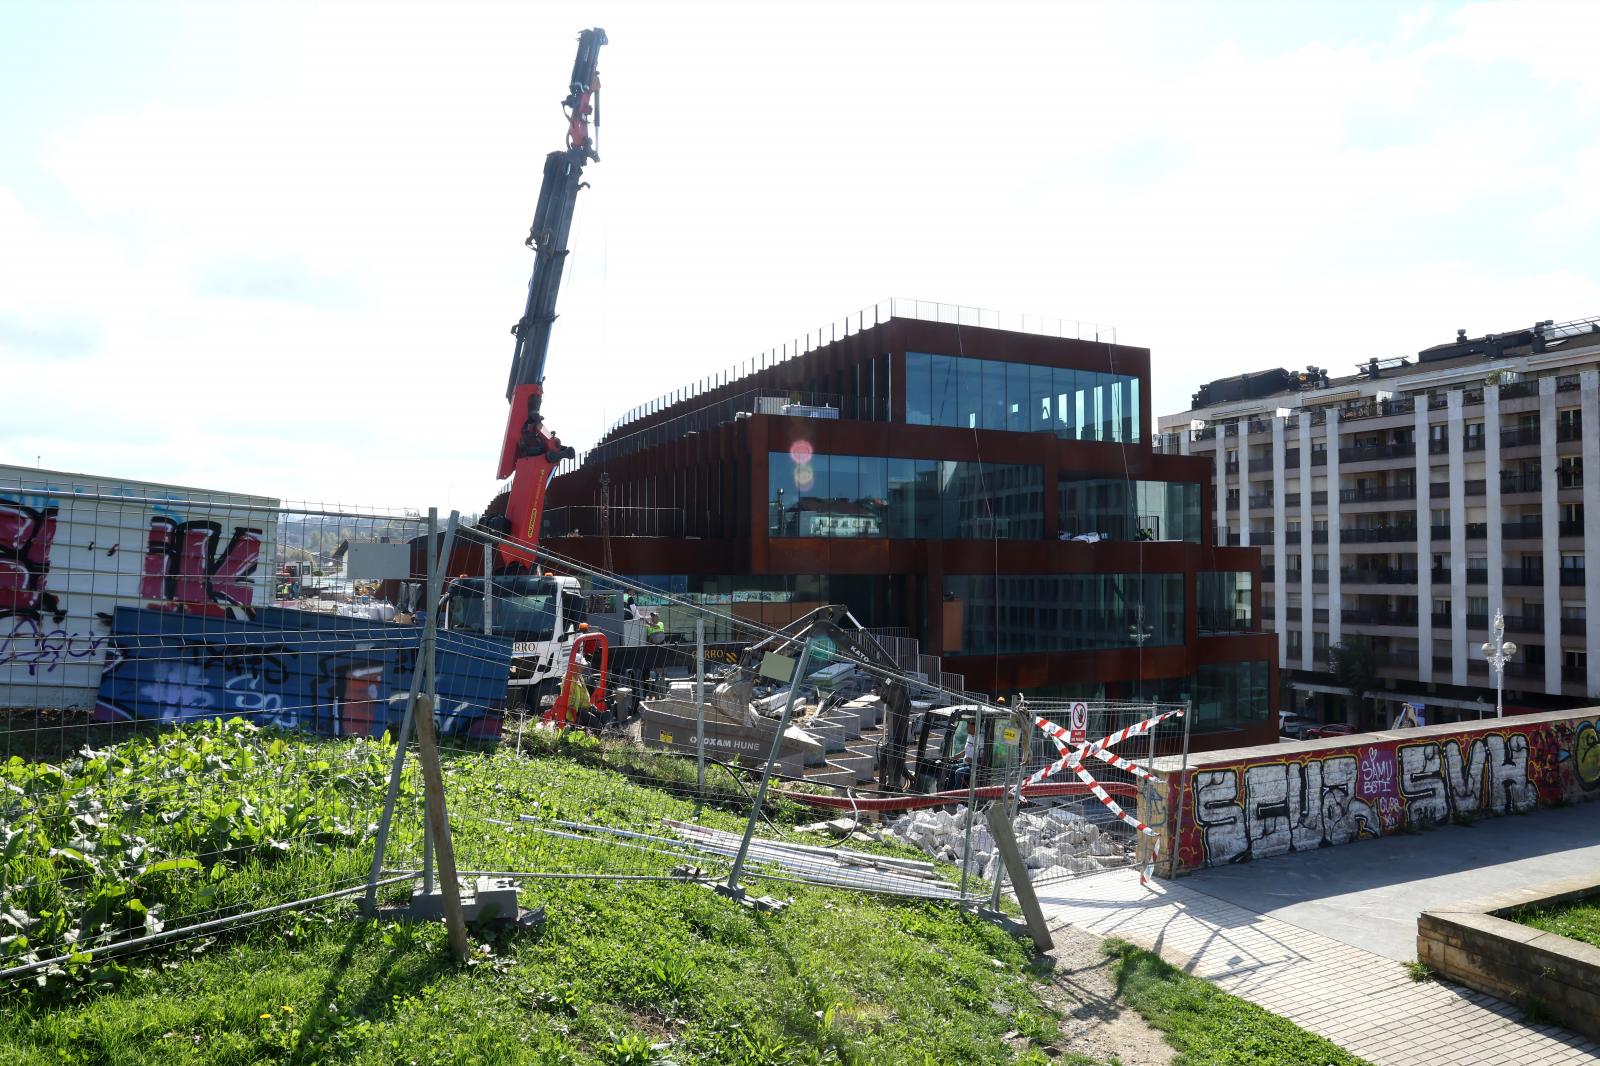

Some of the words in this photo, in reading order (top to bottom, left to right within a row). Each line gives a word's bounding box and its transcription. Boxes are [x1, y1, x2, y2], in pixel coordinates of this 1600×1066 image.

[850, 645, 870, 663] KATO
[699, 736, 732, 748] OXAM
[733, 741, 760, 751] HUNE
